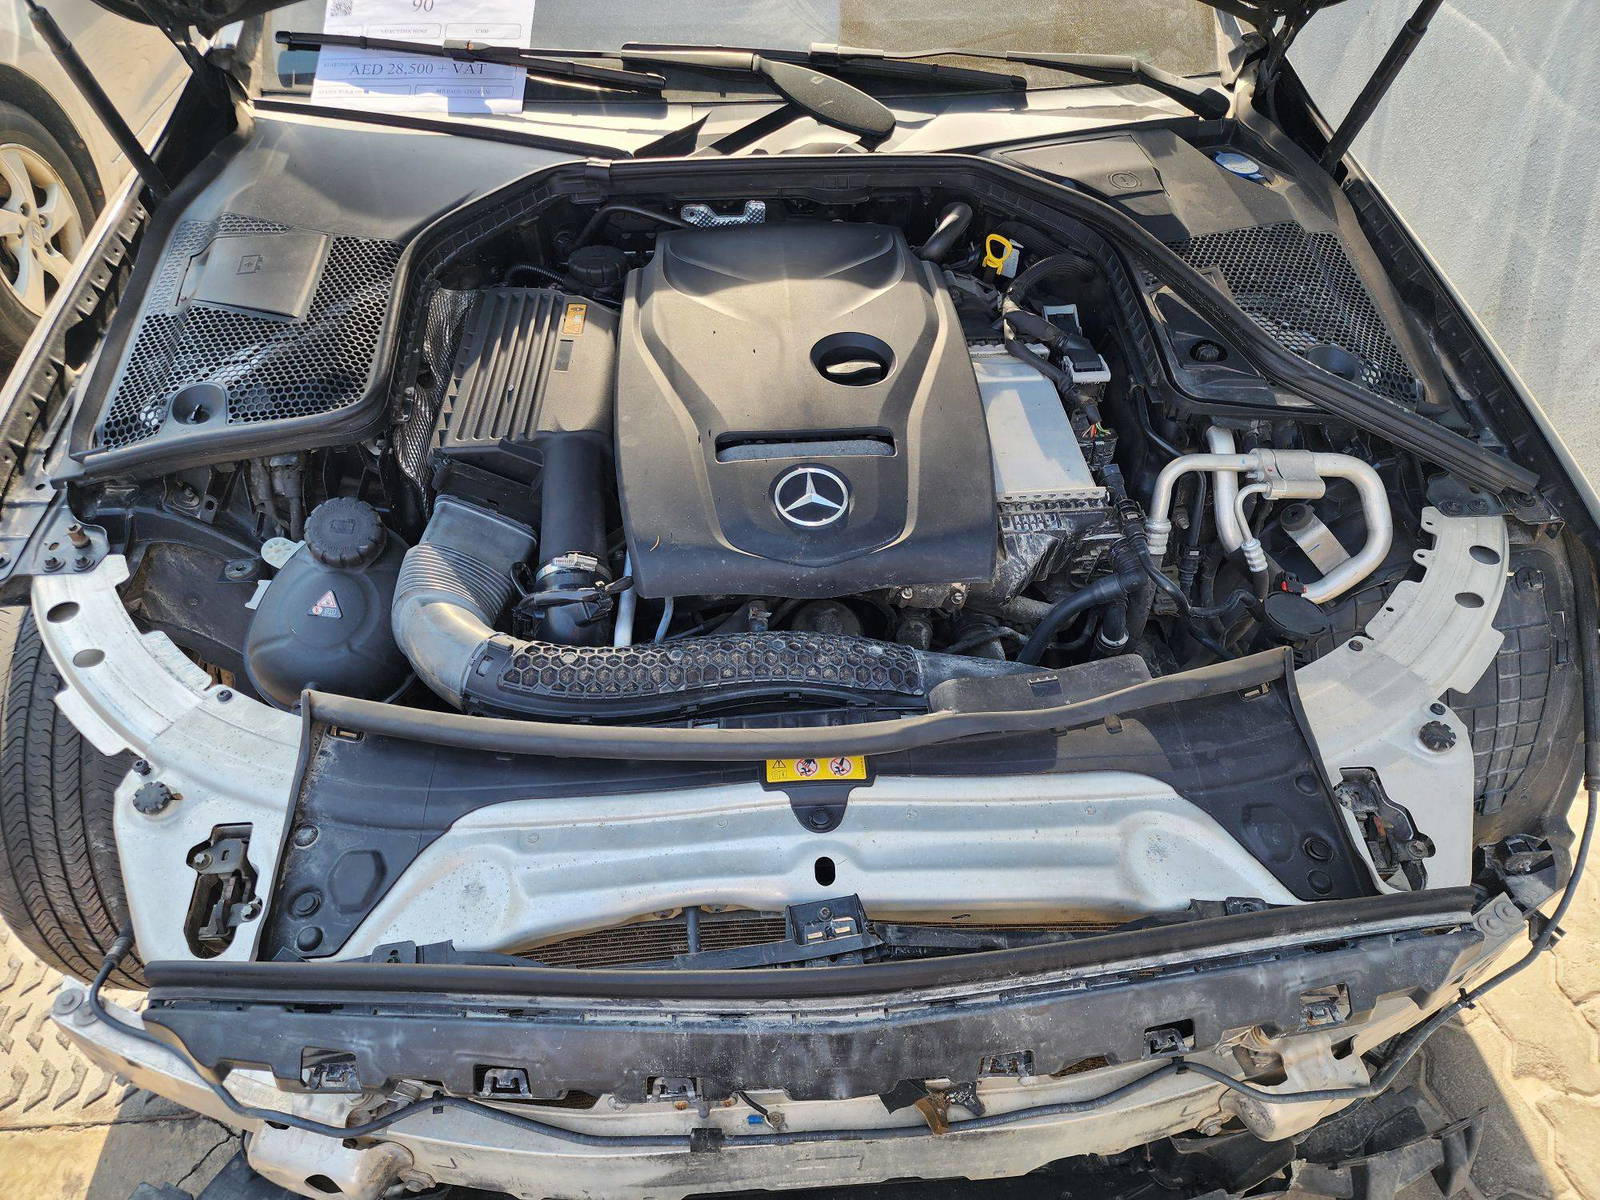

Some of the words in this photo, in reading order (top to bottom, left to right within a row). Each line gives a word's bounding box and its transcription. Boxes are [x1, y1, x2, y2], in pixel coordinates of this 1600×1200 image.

[412, 0, 434, 12] 90
[351, 63, 383, 76] AED
[387, 63, 434, 76] 28,500
[452, 63, 488, 75] VAT
